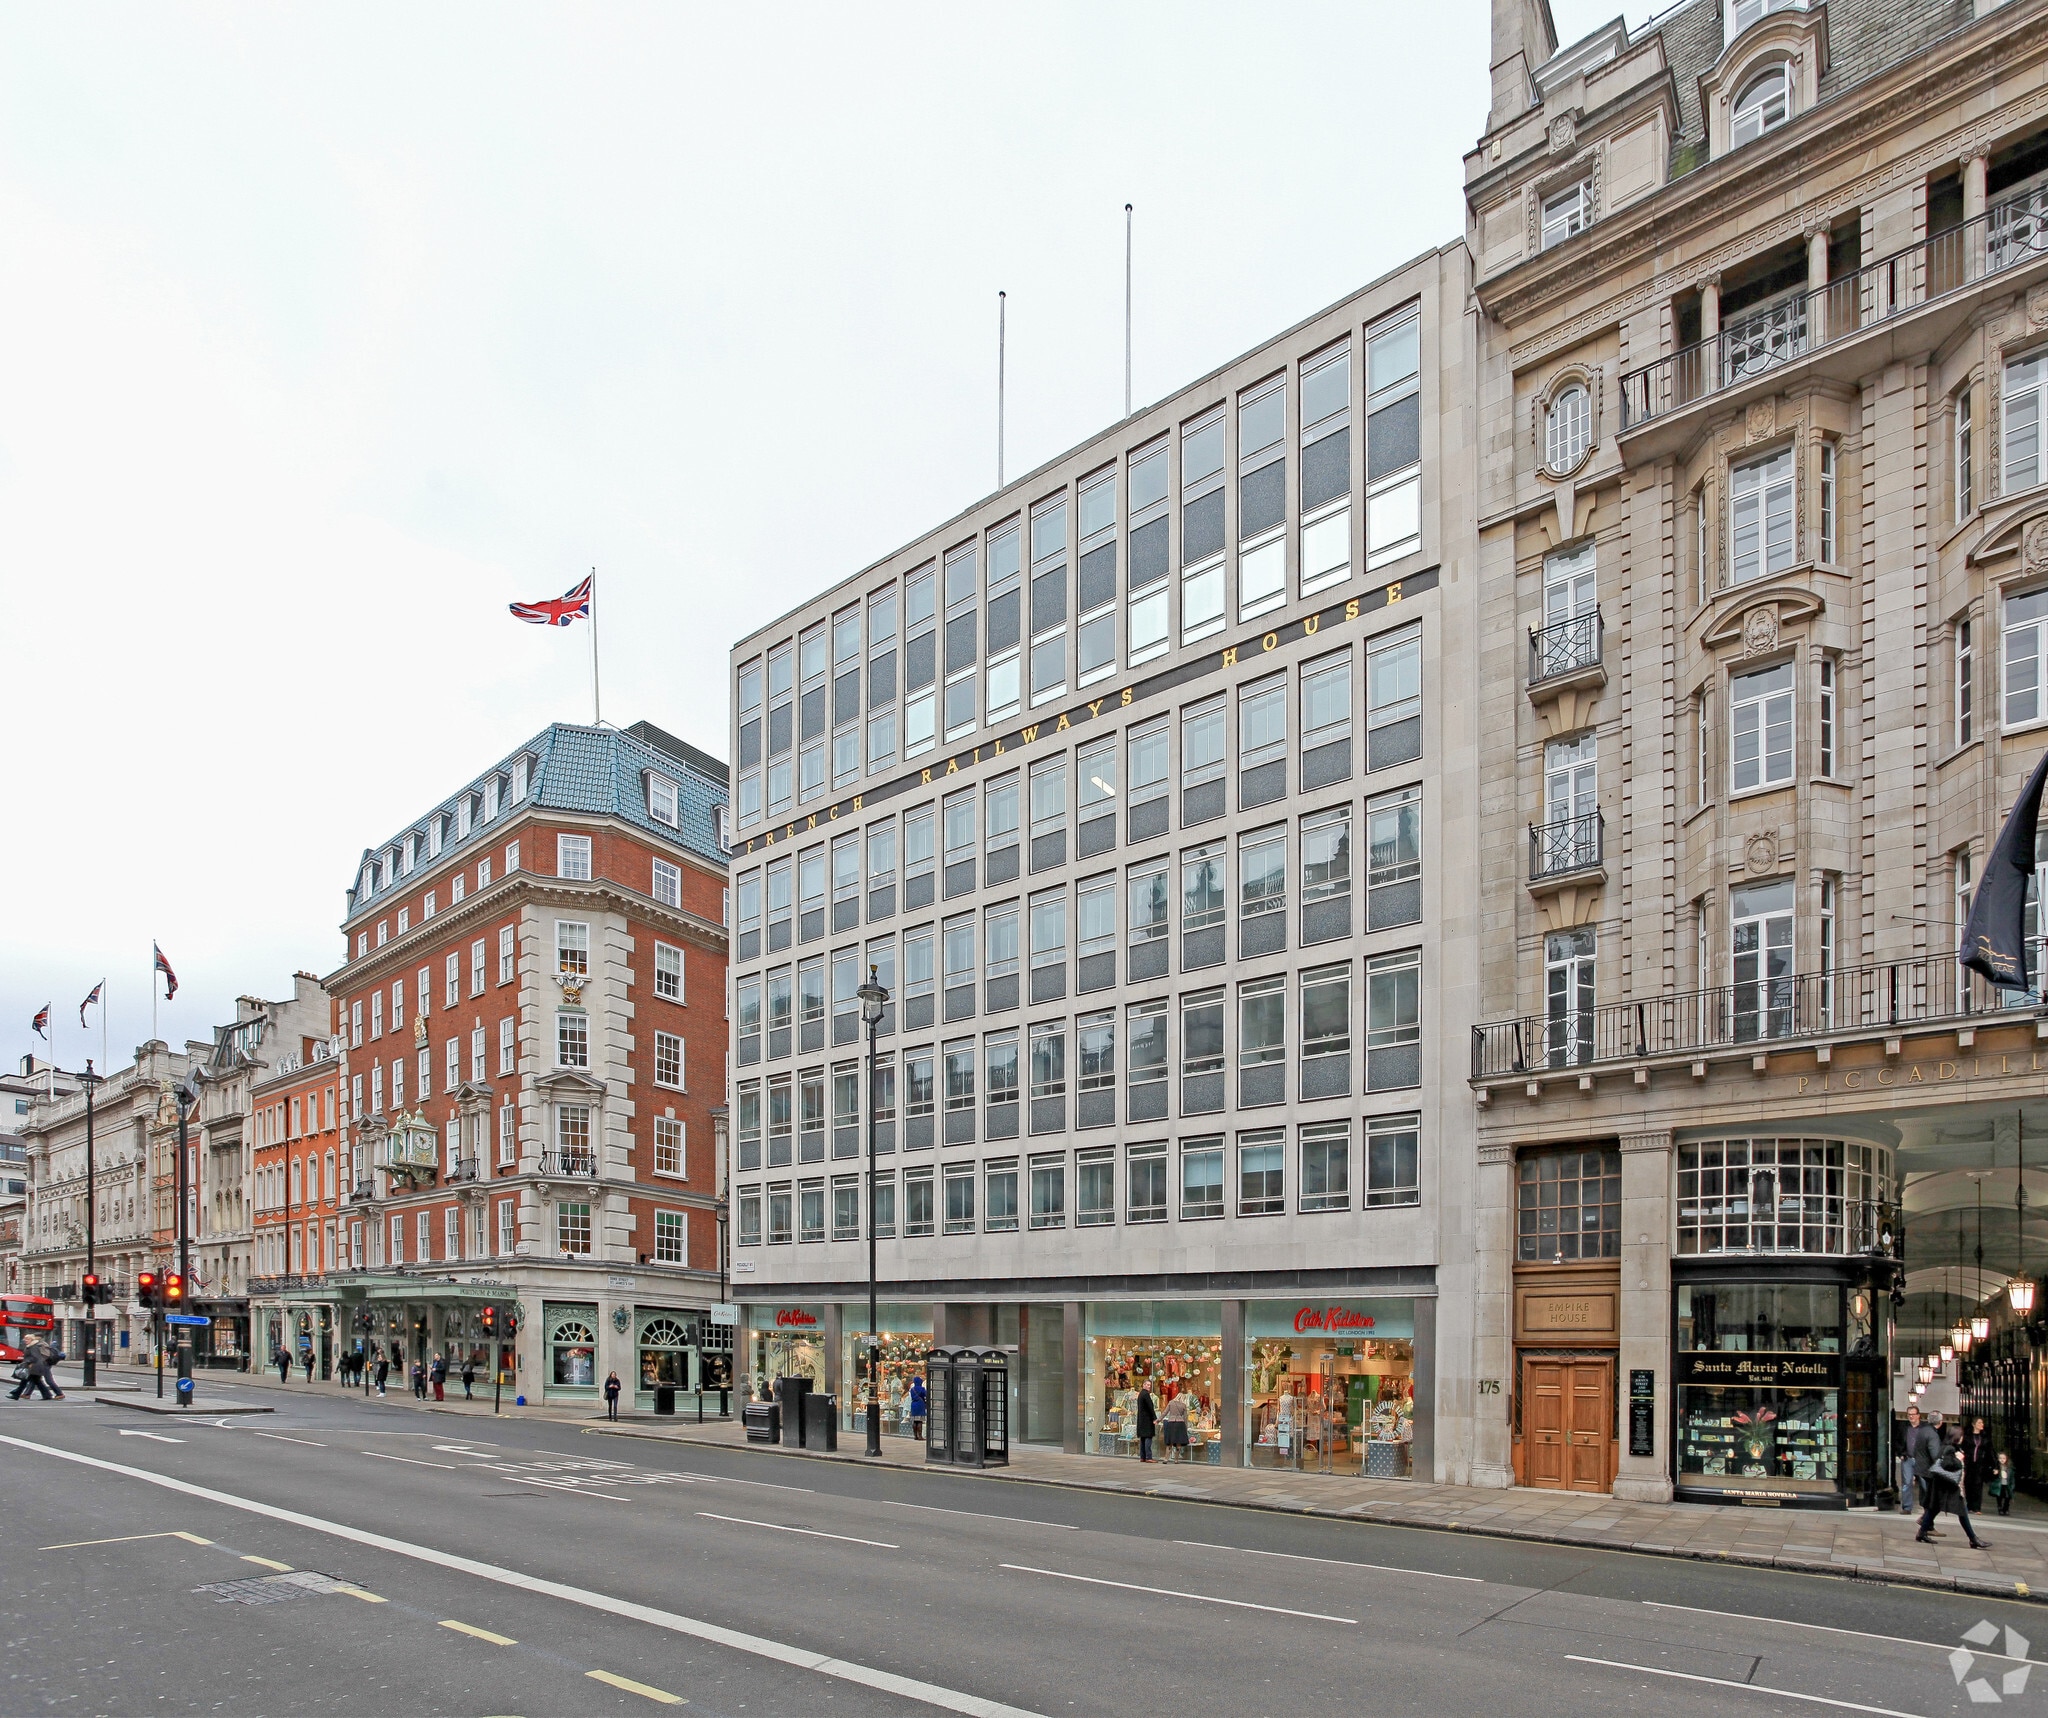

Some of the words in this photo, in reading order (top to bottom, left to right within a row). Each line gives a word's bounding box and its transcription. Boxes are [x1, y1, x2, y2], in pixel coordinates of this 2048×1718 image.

[746, 796, 863, 855] FRENCH
[921, 688, 1133, 786] RAILWAYS
[1222, 582, 1403, 670] HOUSE
[1548, 1302, 1590, 1312] EMPIRE
[775, 1309, 791, 1327] Cath
[790, 1308, 817, 1327] Kidston
[1293, 1307, 1323, 1333] Cath
[1323, 1305, 1376, 1332] Kidston
[1550, 1313, 1588, 1323] HOUSE
[1692, 1360, 1732, 1375] Santa
[1735, 1360, 1778, 1376] Maria
[1781, 1361, 1828, 1376] Novella
[1748, 1374, 1762, 1382] Est.
[1478, 1380, 1501, 1395] 175
[1767, 1491, 1799, 1499] NOVELLA
